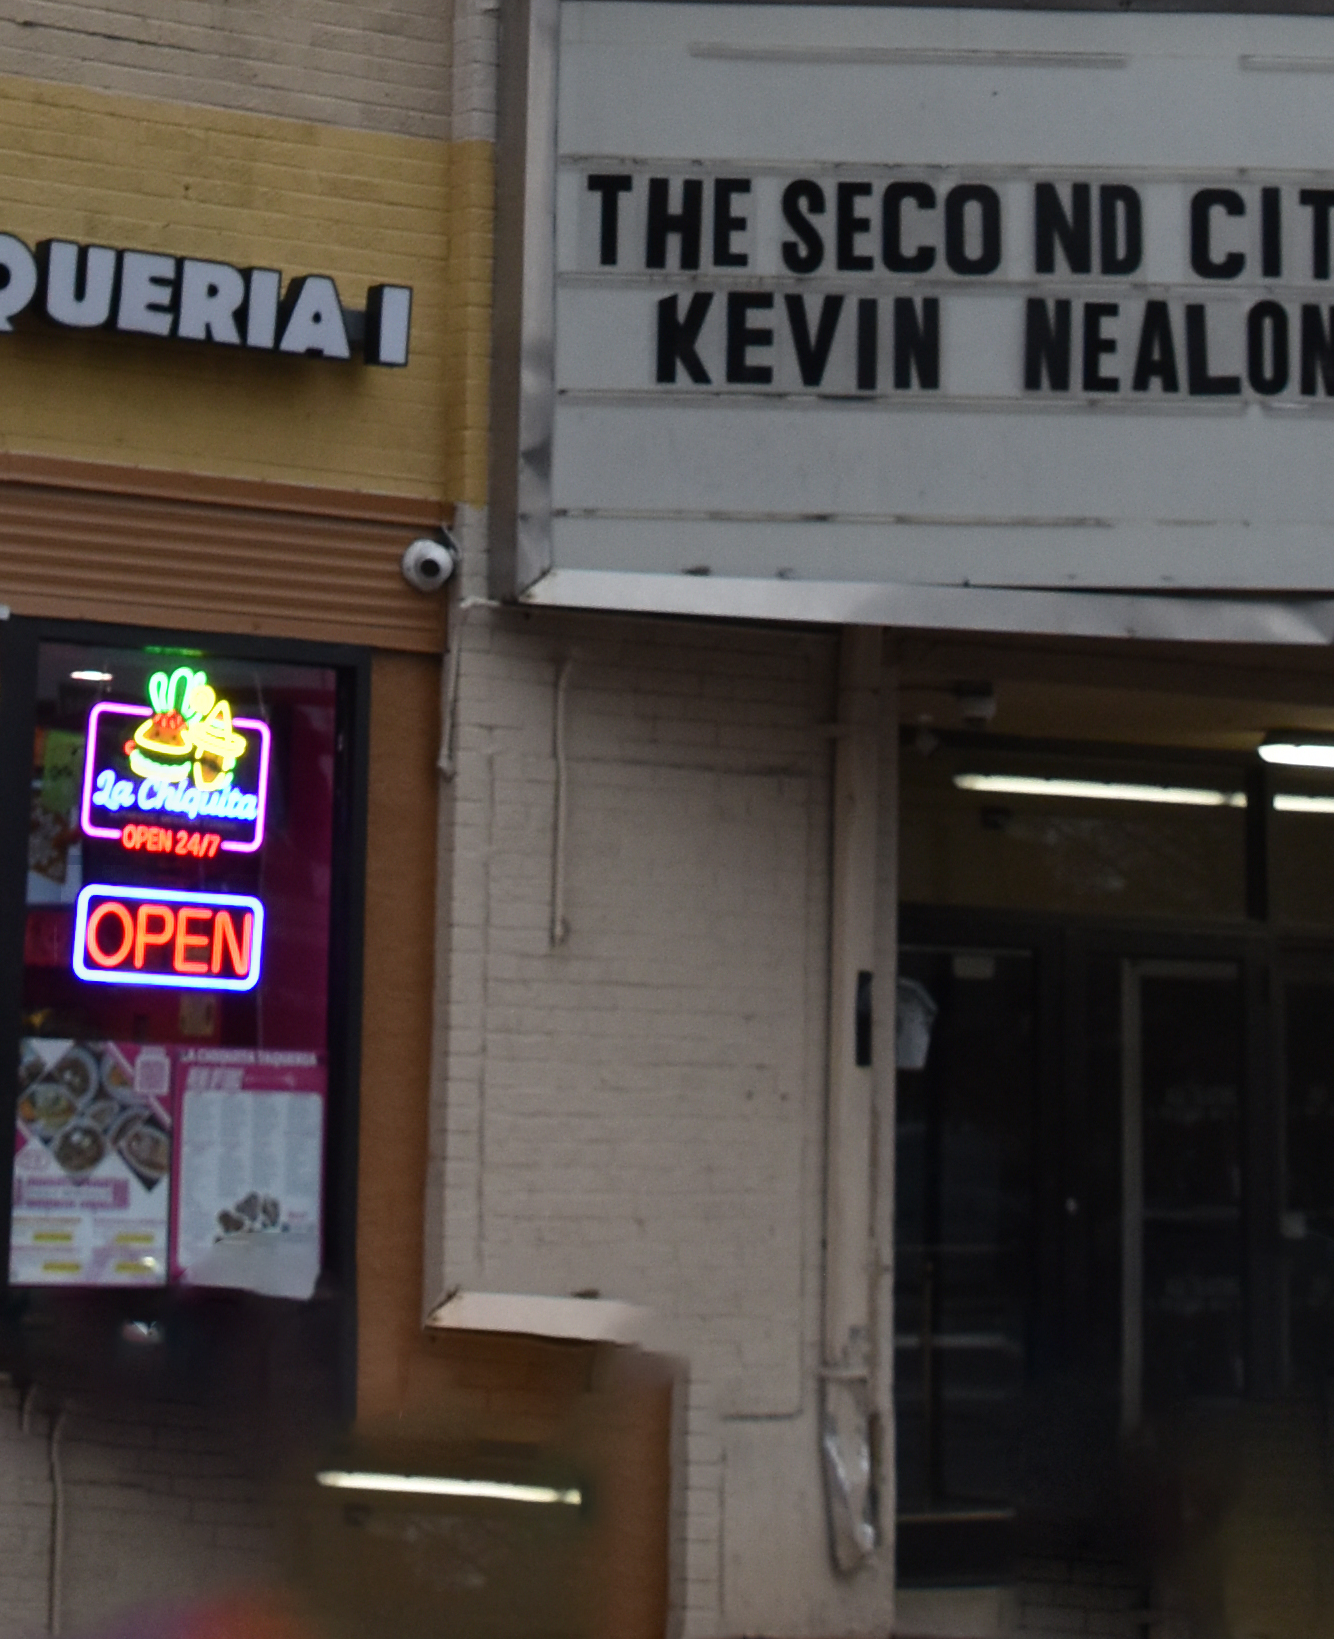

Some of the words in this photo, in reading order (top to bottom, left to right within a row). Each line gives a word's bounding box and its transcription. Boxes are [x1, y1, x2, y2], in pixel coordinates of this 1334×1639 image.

[587, 173, 752, 272] THE
[781, 178, 1144, 277] SECOND
[655, 291, 941, 391] KEVIN
[92, 769, 136, 812] La
[137, 775, 258, 821] Chiquita
[121, 823, 174, 854] OPEN
[174, 829, 222, 858] 24/7
[86, 900, 255, 977] OPEN
